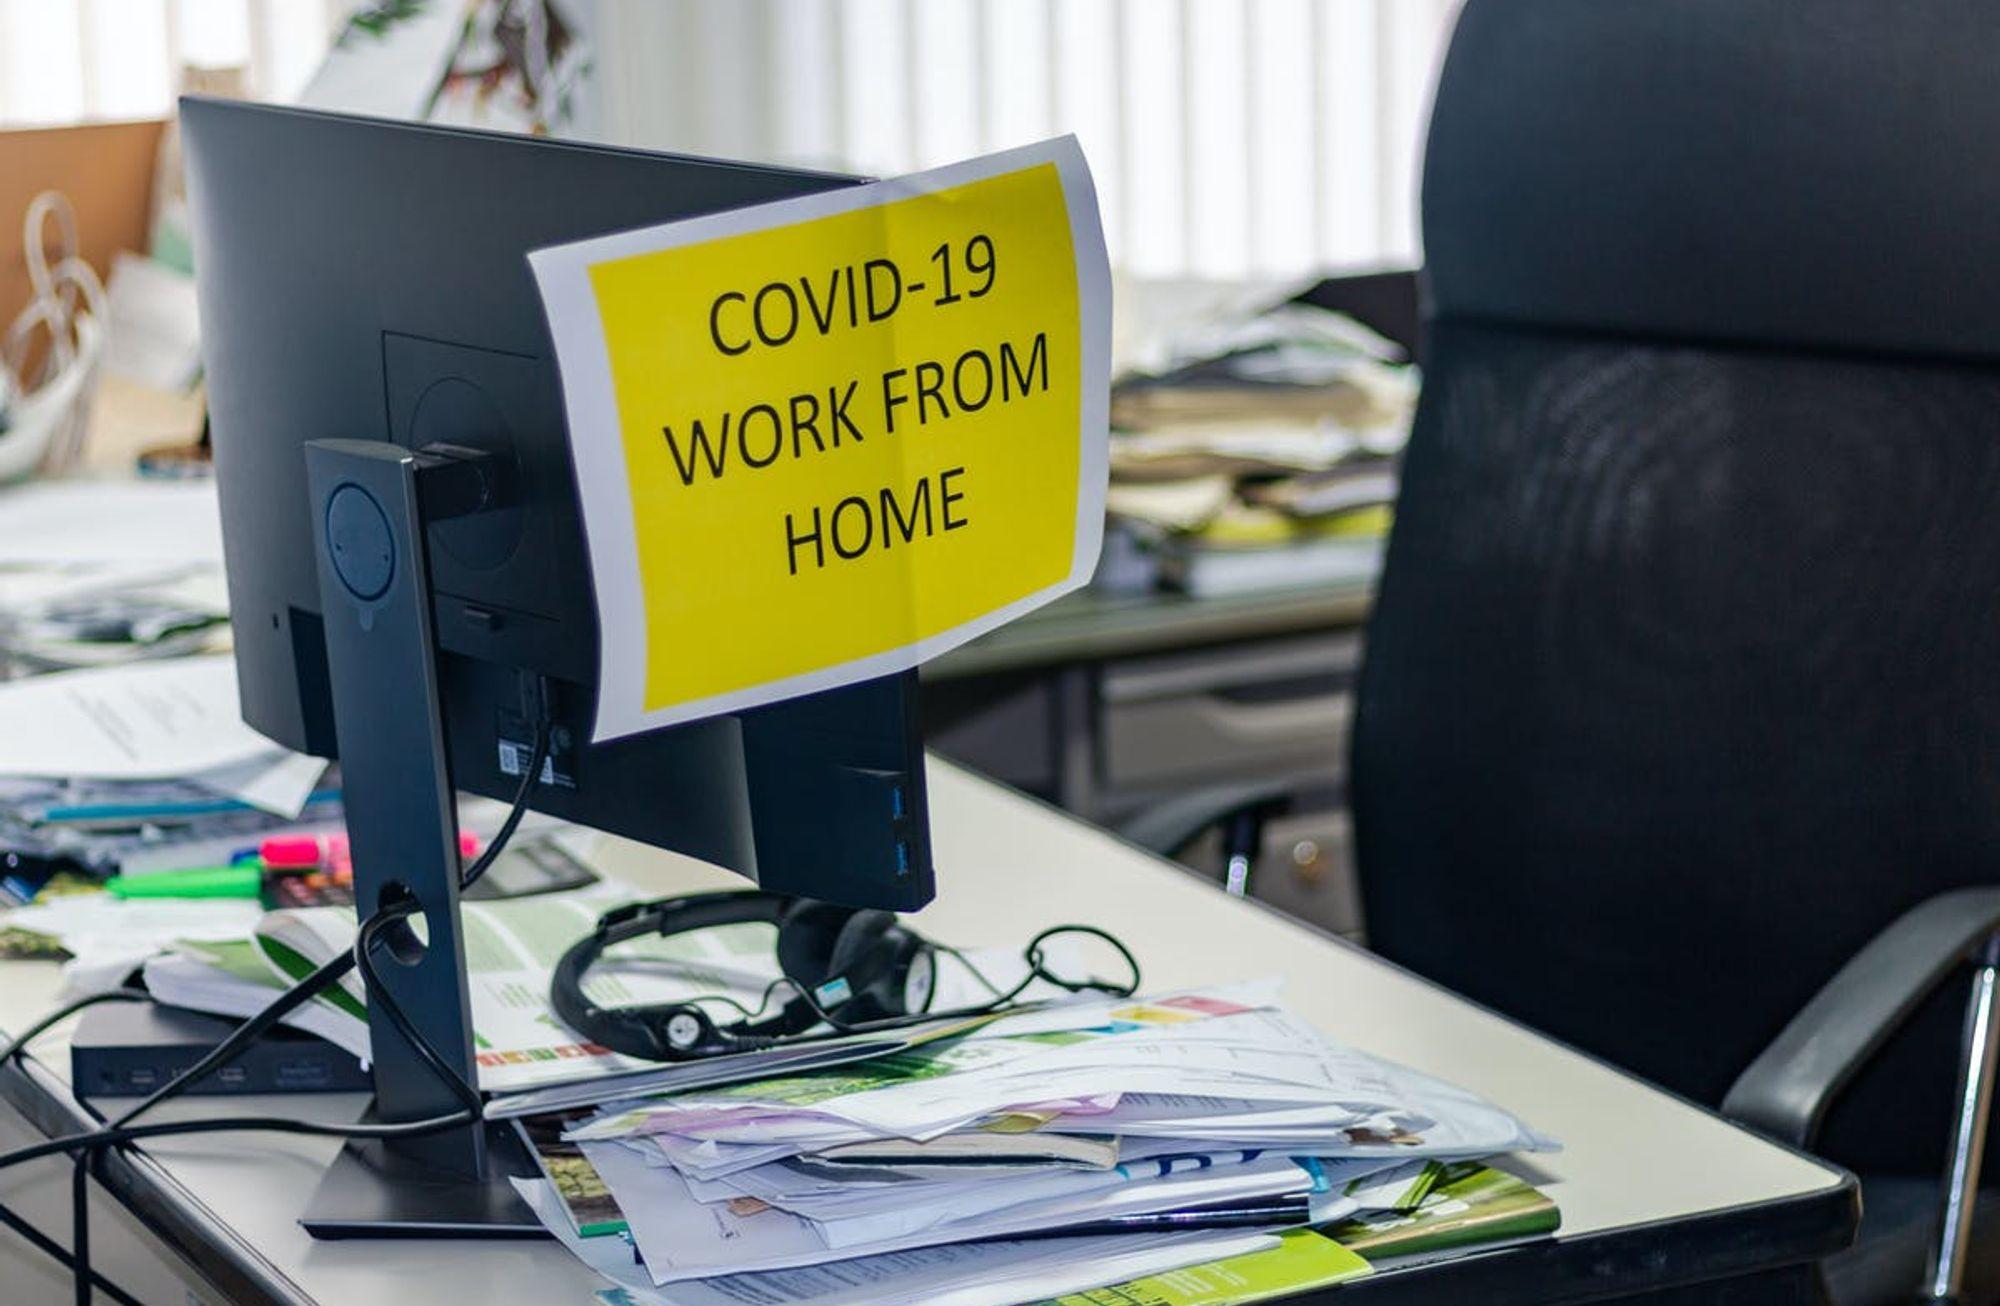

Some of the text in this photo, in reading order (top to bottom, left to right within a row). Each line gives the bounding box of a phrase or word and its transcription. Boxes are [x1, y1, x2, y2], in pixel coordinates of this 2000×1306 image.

[709, 234, 996, 356] COVID-19
[663, 332, 1049, 486] WORK FROM
[785, 467, 969, 575] HOME
